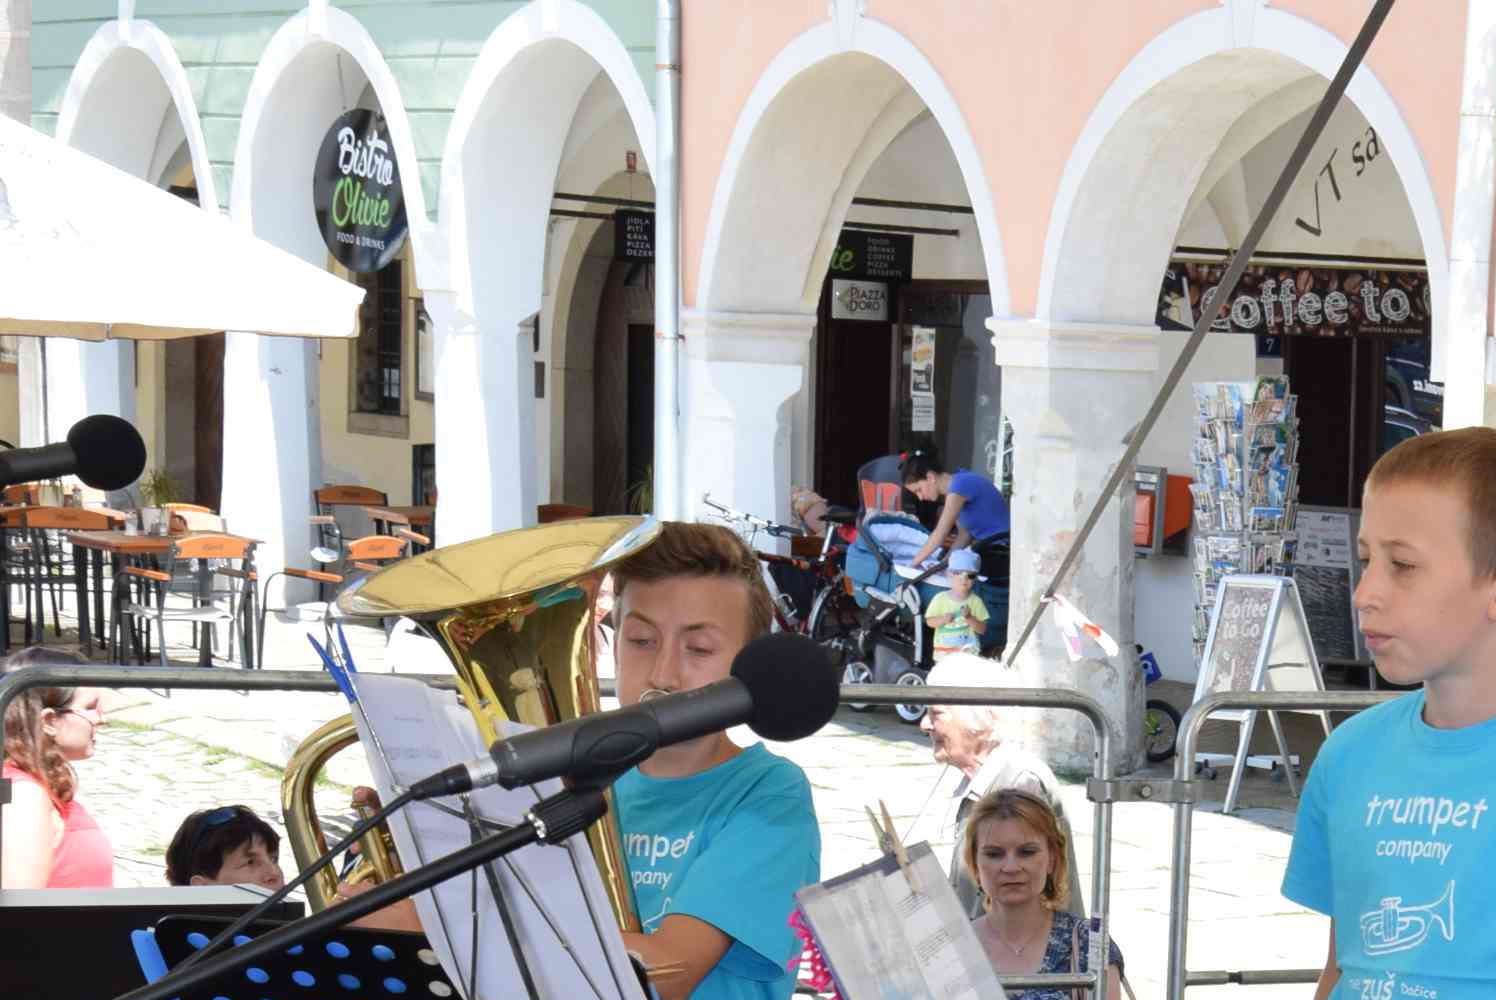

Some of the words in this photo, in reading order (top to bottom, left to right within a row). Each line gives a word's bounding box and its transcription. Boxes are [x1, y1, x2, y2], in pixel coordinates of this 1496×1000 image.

[337, 126, 394, 186] Bistro
[332, 176, 391, 228] Olivie
[335, 231, 354, 245] FOOD
[361, 235, 385, 250] DRINKS
[850, 286, 886, 299] PIAZZA
[1200, 278, 1349, 331] Coffee
[1360, 281, 1411, 323] to
[1265, 338, 1274, 352] 7
[1222, 595, 1268, 618] Coffee
[1222, 620, 1237, 639] to
[1241, 620, 1260, 638] Go
[1365, 794, 1489, 836] trumpet
[1375, 838, 1453, 866] company
[631, 870, 673, 891] pany
